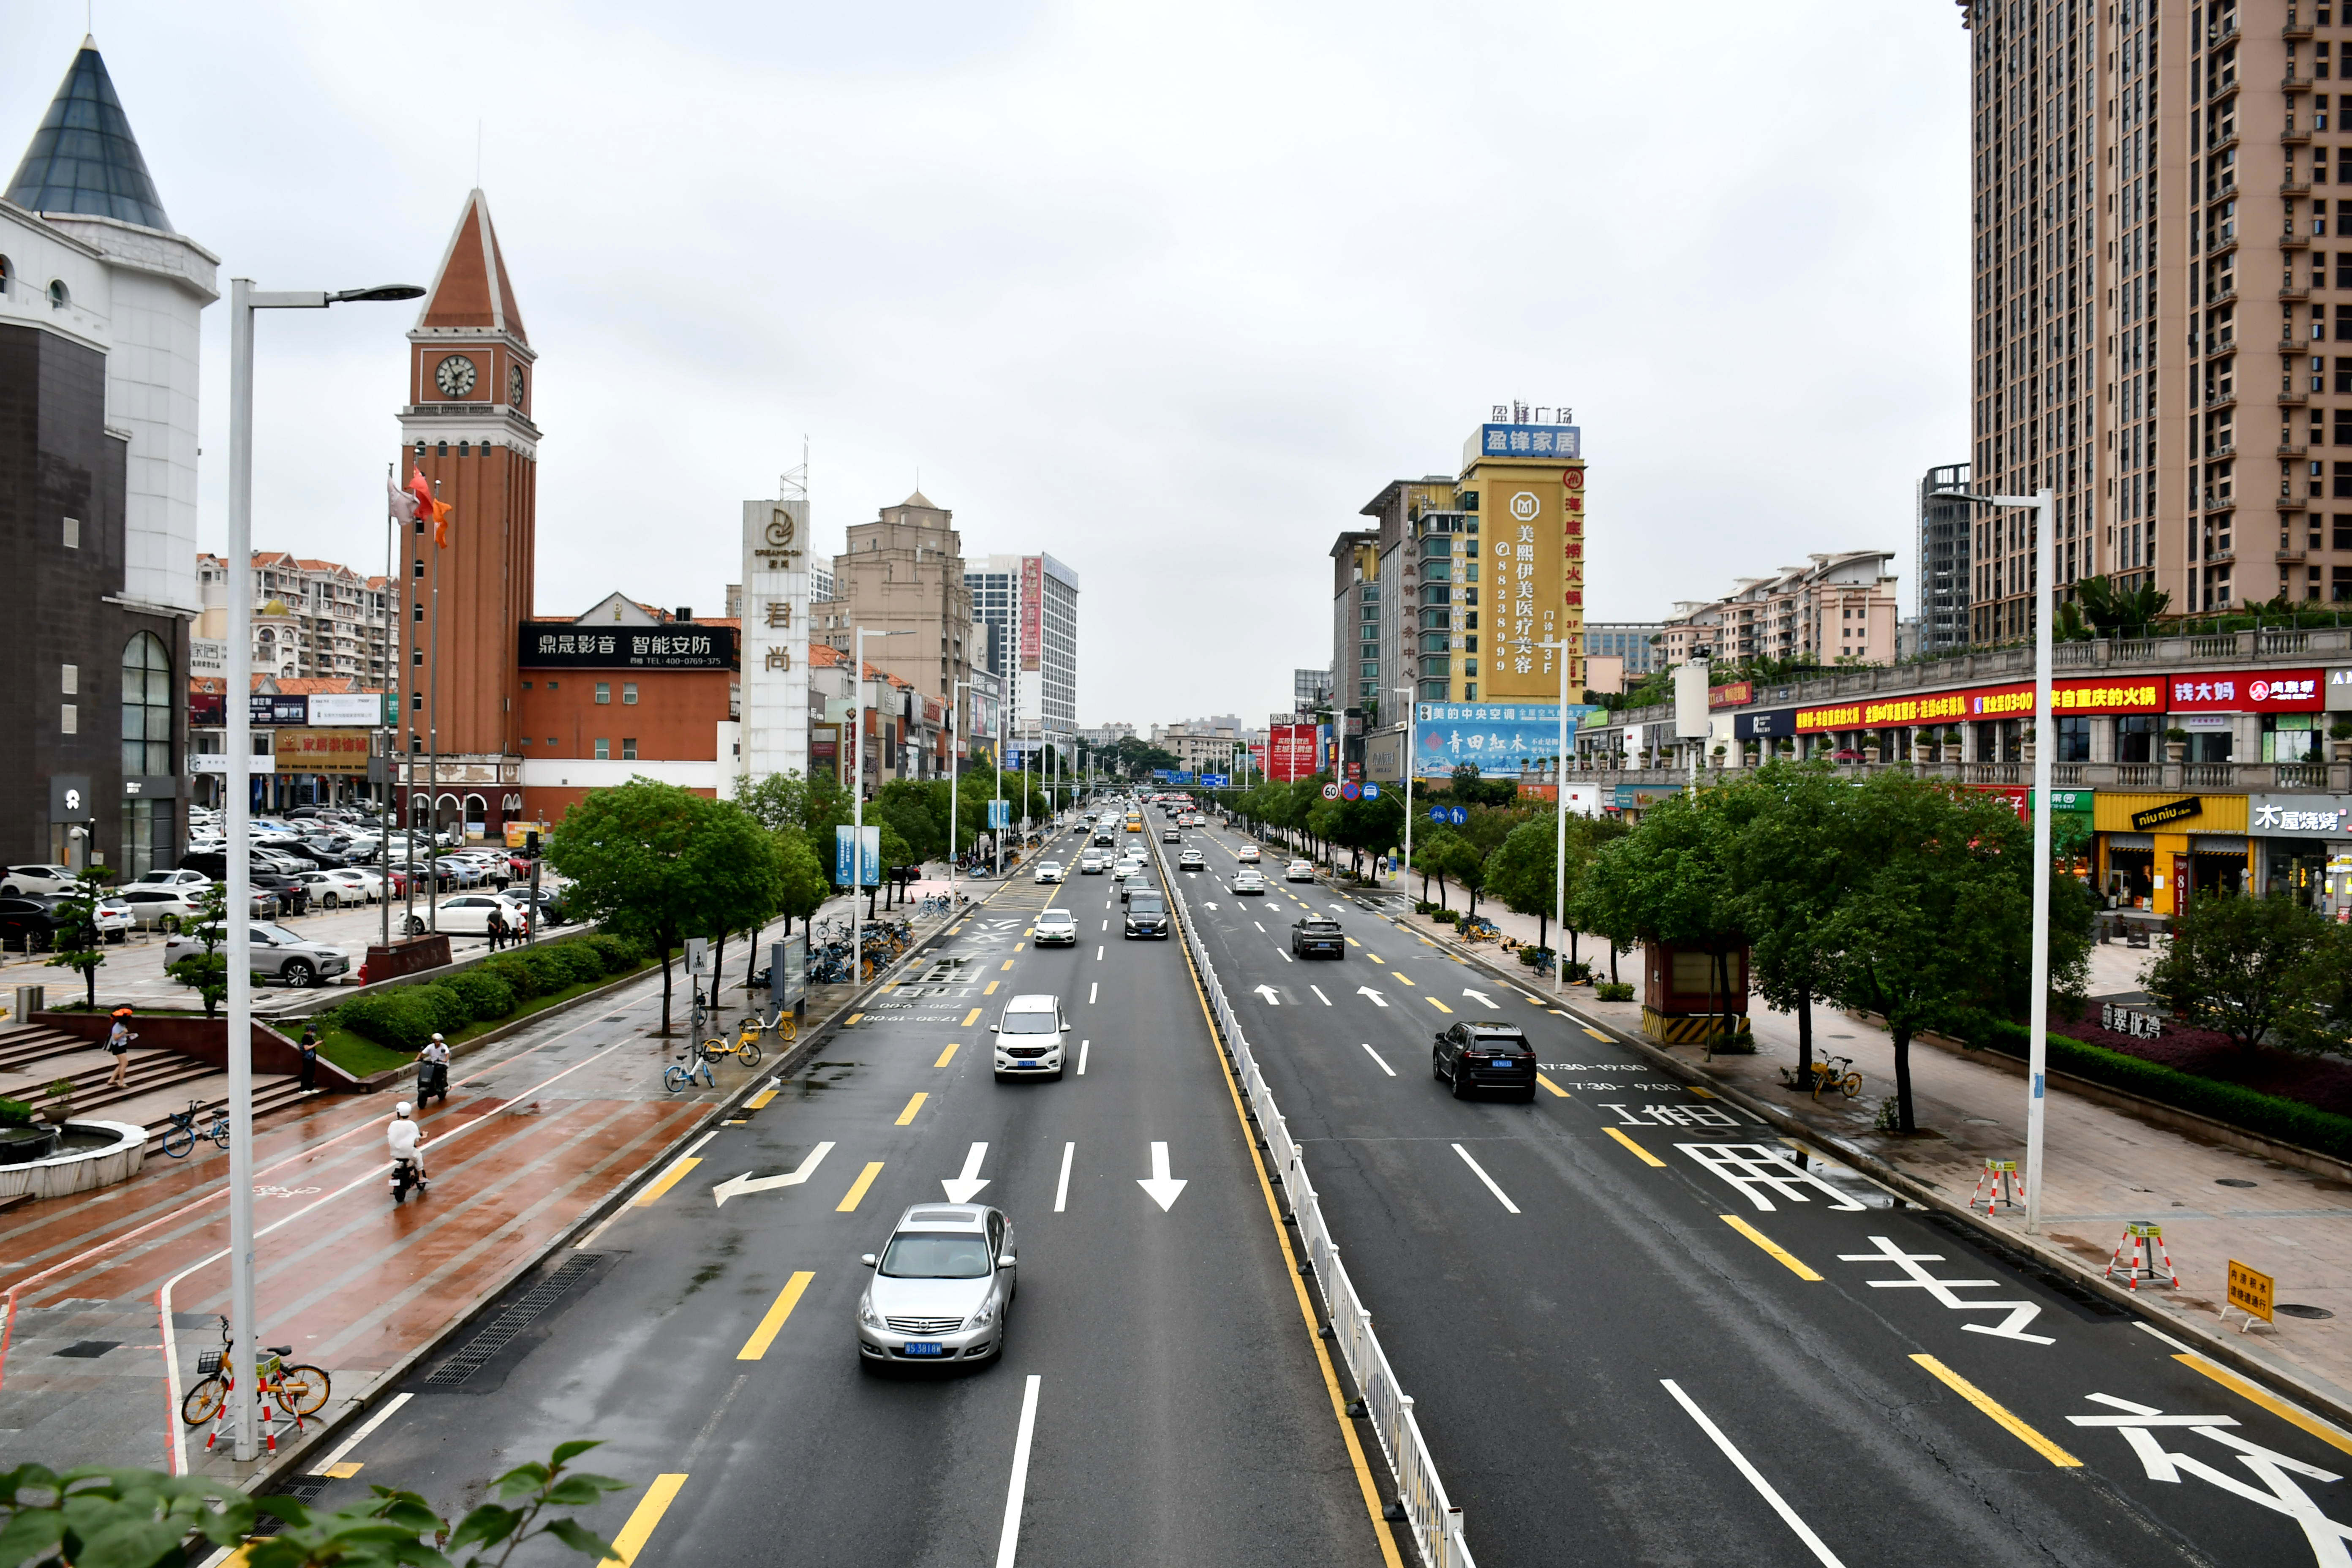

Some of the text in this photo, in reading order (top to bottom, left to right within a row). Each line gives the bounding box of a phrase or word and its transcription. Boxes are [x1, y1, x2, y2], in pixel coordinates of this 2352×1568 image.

[1487, 430, 1575, 452] 盈锋家居
[1565, 496, 1582, 606] 海底捞火锅
[1515, 525, 1534, 674] 美熙伊美医疗美容
[1567, 620, 1578, 628] 3F
[538, 635, 711, 655] 鼎晟影音 智能安防
[764, 602, 792, 672] 君尚
[2175, 681, 2235, 702] 钱大妈
[1433, 708, 1515, 720] 美的中央空调
[1982, 692, 2033, 714] 营业至03:00
[1325, 787, 1336, 796] 60
[2254, 804, 2339, 831] 木屋烧烤
[1598, 1104, 1742, 1127] 工作日
